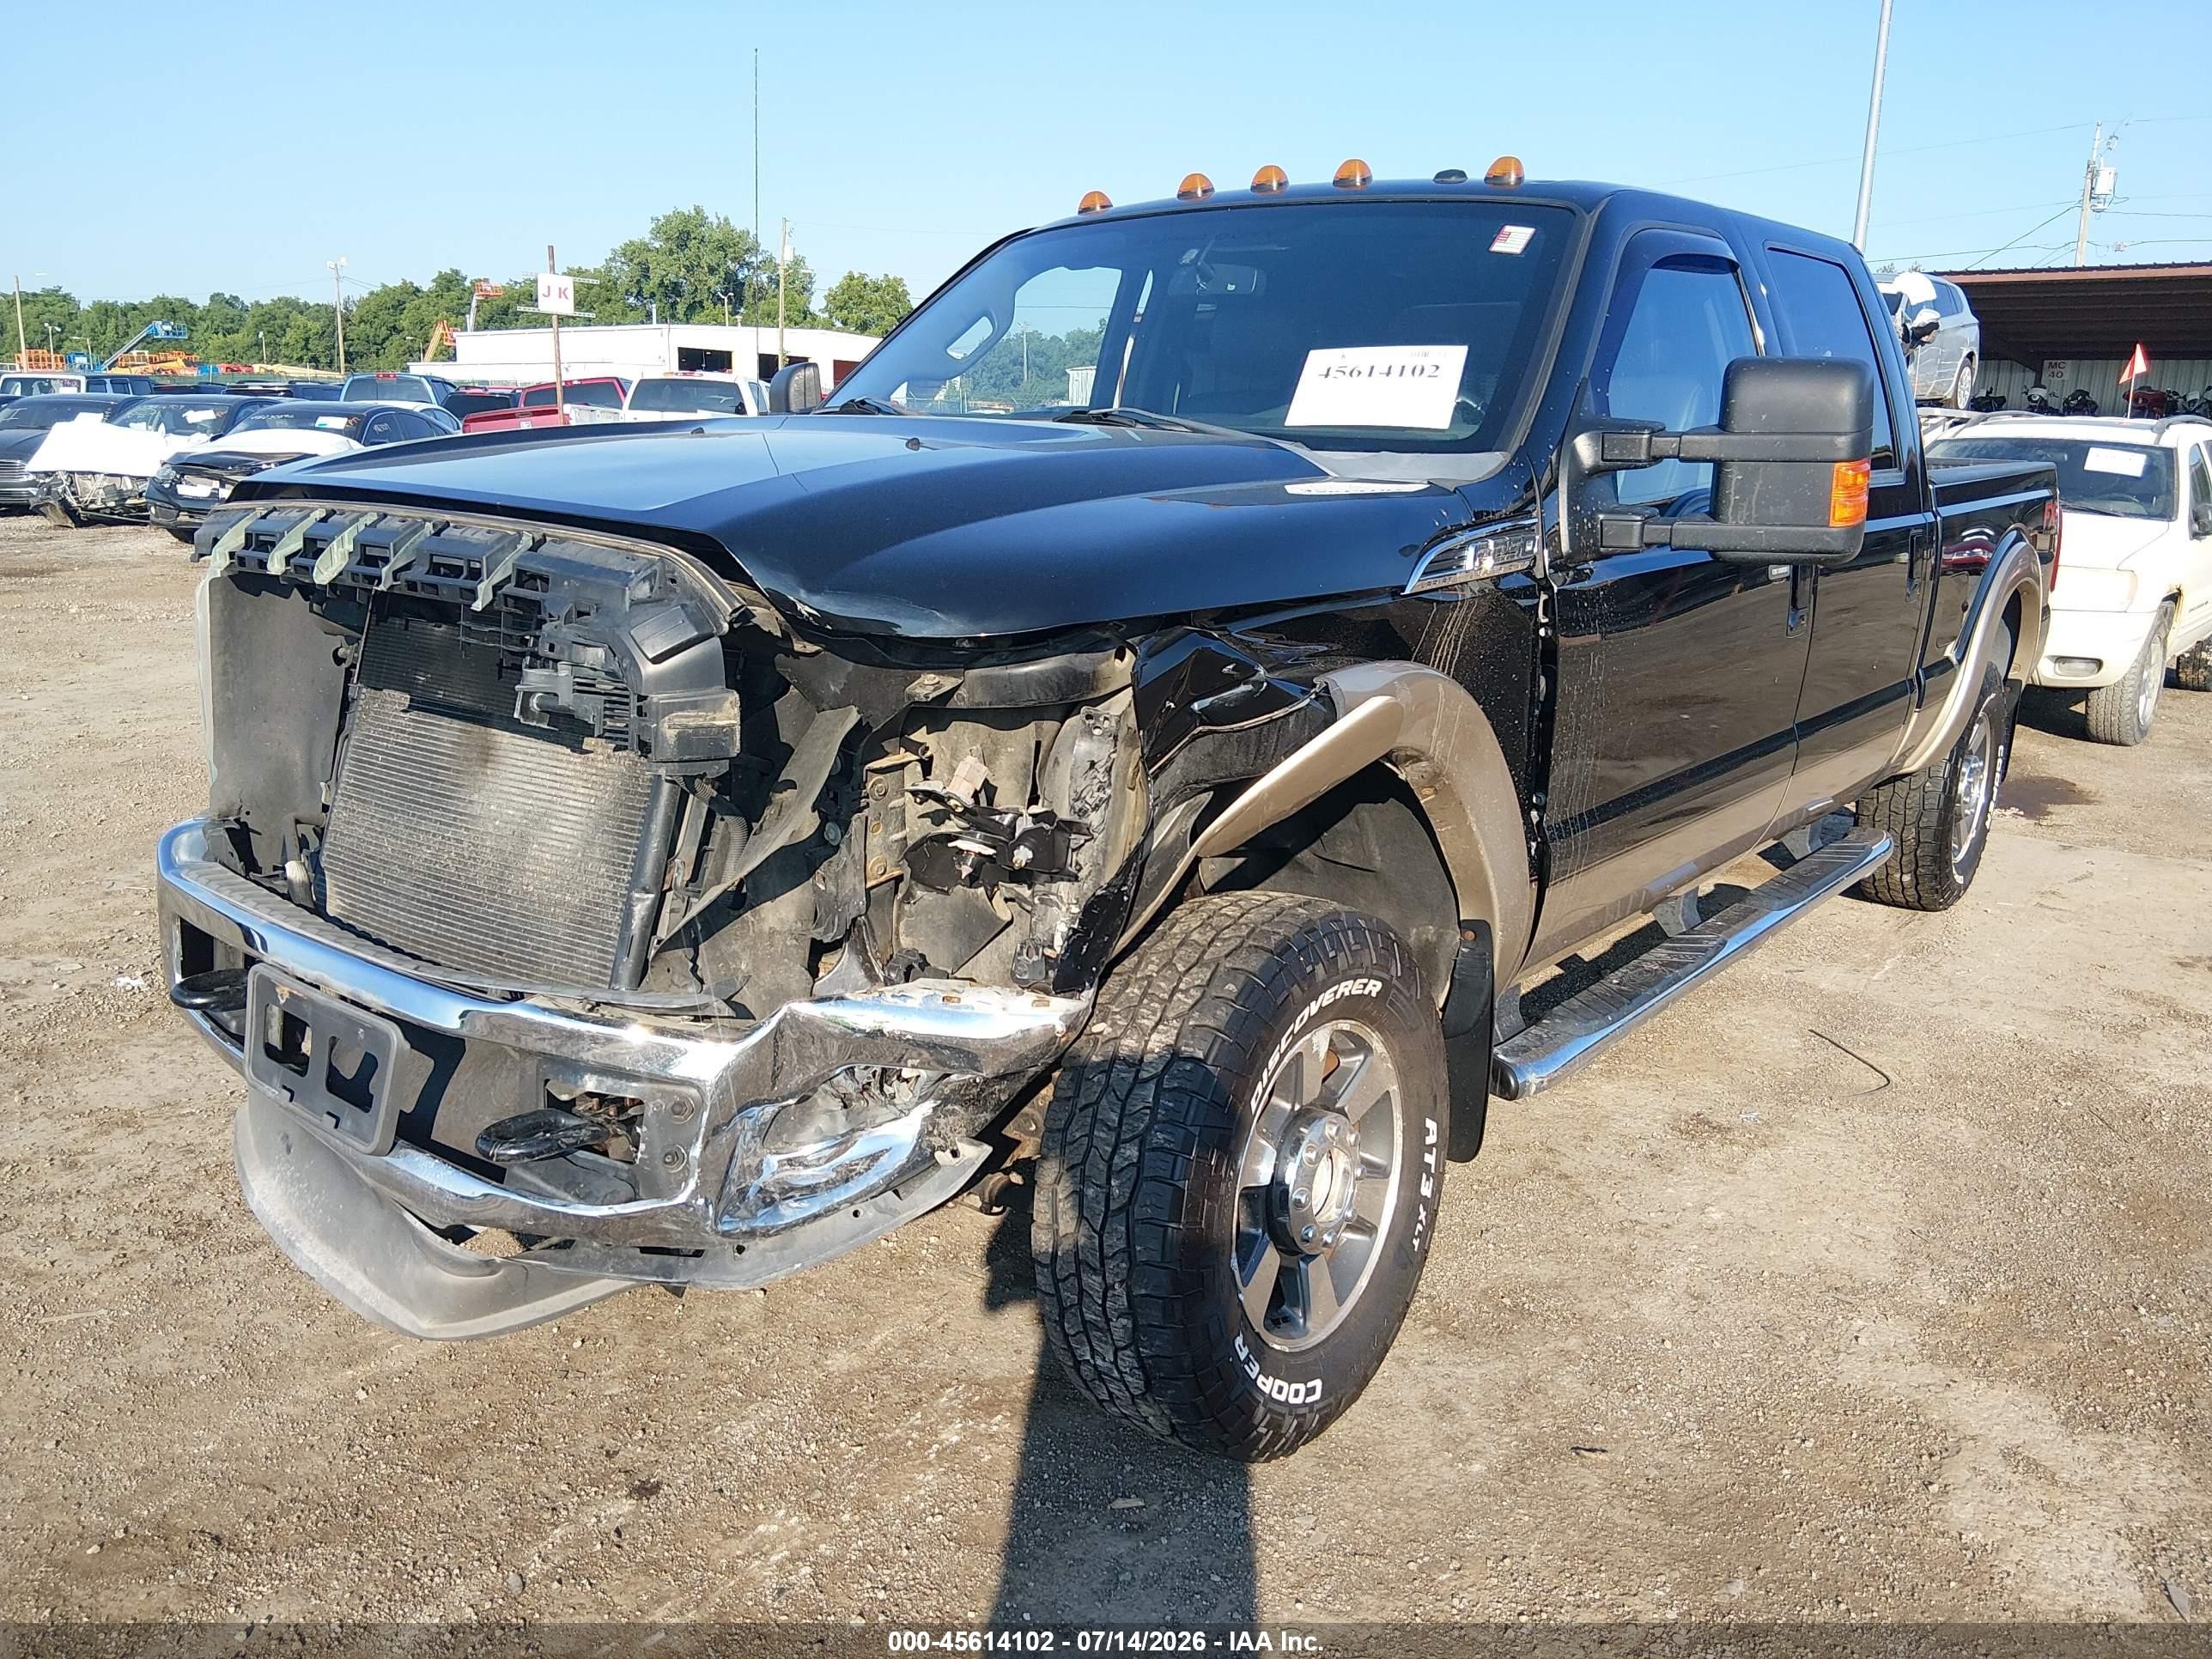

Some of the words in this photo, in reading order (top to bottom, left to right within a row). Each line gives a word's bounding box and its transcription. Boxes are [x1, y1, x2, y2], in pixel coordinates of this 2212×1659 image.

[542, 285, 551, 298] J
[557, 286, 569, 301] K
[1319, 363, 1441, 380] 45614102
[2047, 361, 2067, 370] MC
[1250, 978, 1383, 1115] DISCOVERER
[1419, 1117, 1437, 1199] AT3
[1234, 1330, 1322, 1405] COOPER
